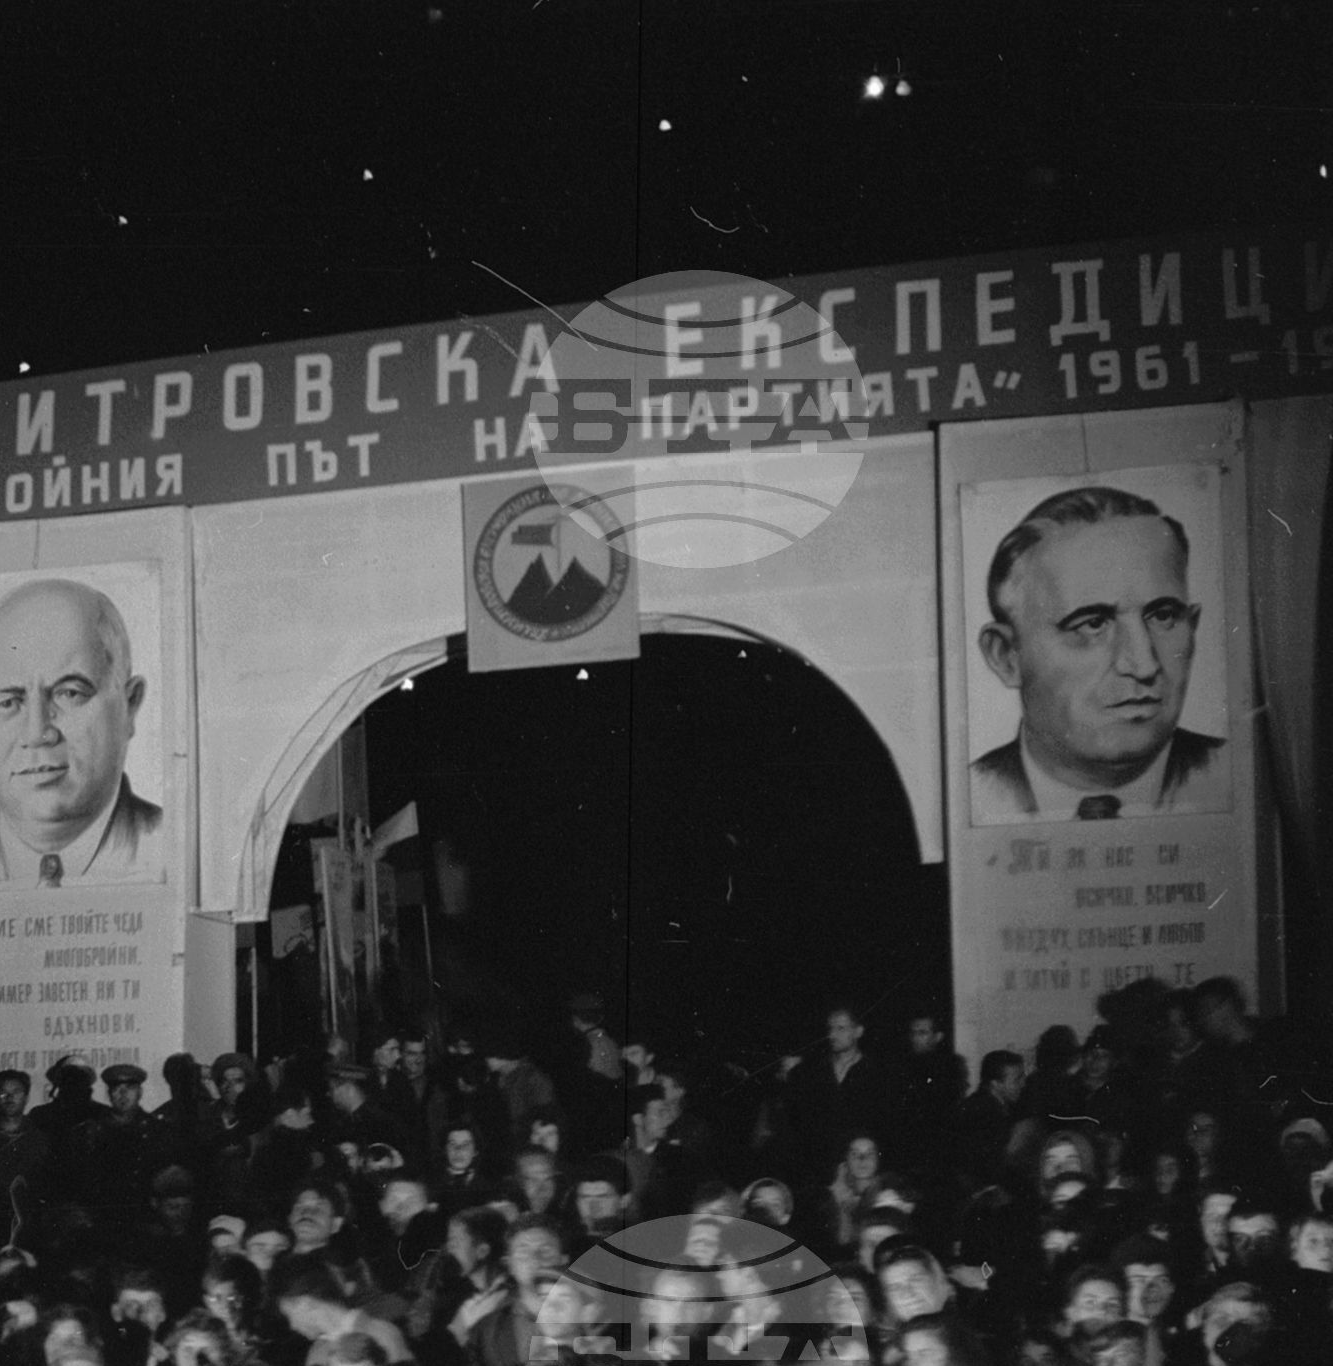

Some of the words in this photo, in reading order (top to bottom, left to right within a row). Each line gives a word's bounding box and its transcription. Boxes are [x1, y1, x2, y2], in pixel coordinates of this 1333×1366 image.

[266, 432, 381, 487] ПЪТ
[473, 411, 550, 461] НА
[1058, 331, 1200, 400] 1961
[24, 915, 54, 937] СМЕ
[61, 908, 110, 935] ТВОЙТЕ
[113, 911, 143, 936] ЧЕДА
[38, 980, 89, 1003] ЗАВЕТЕН
[96, 980, 116, 1001] НИ
[122, 979, 141, 1000] ТИ
